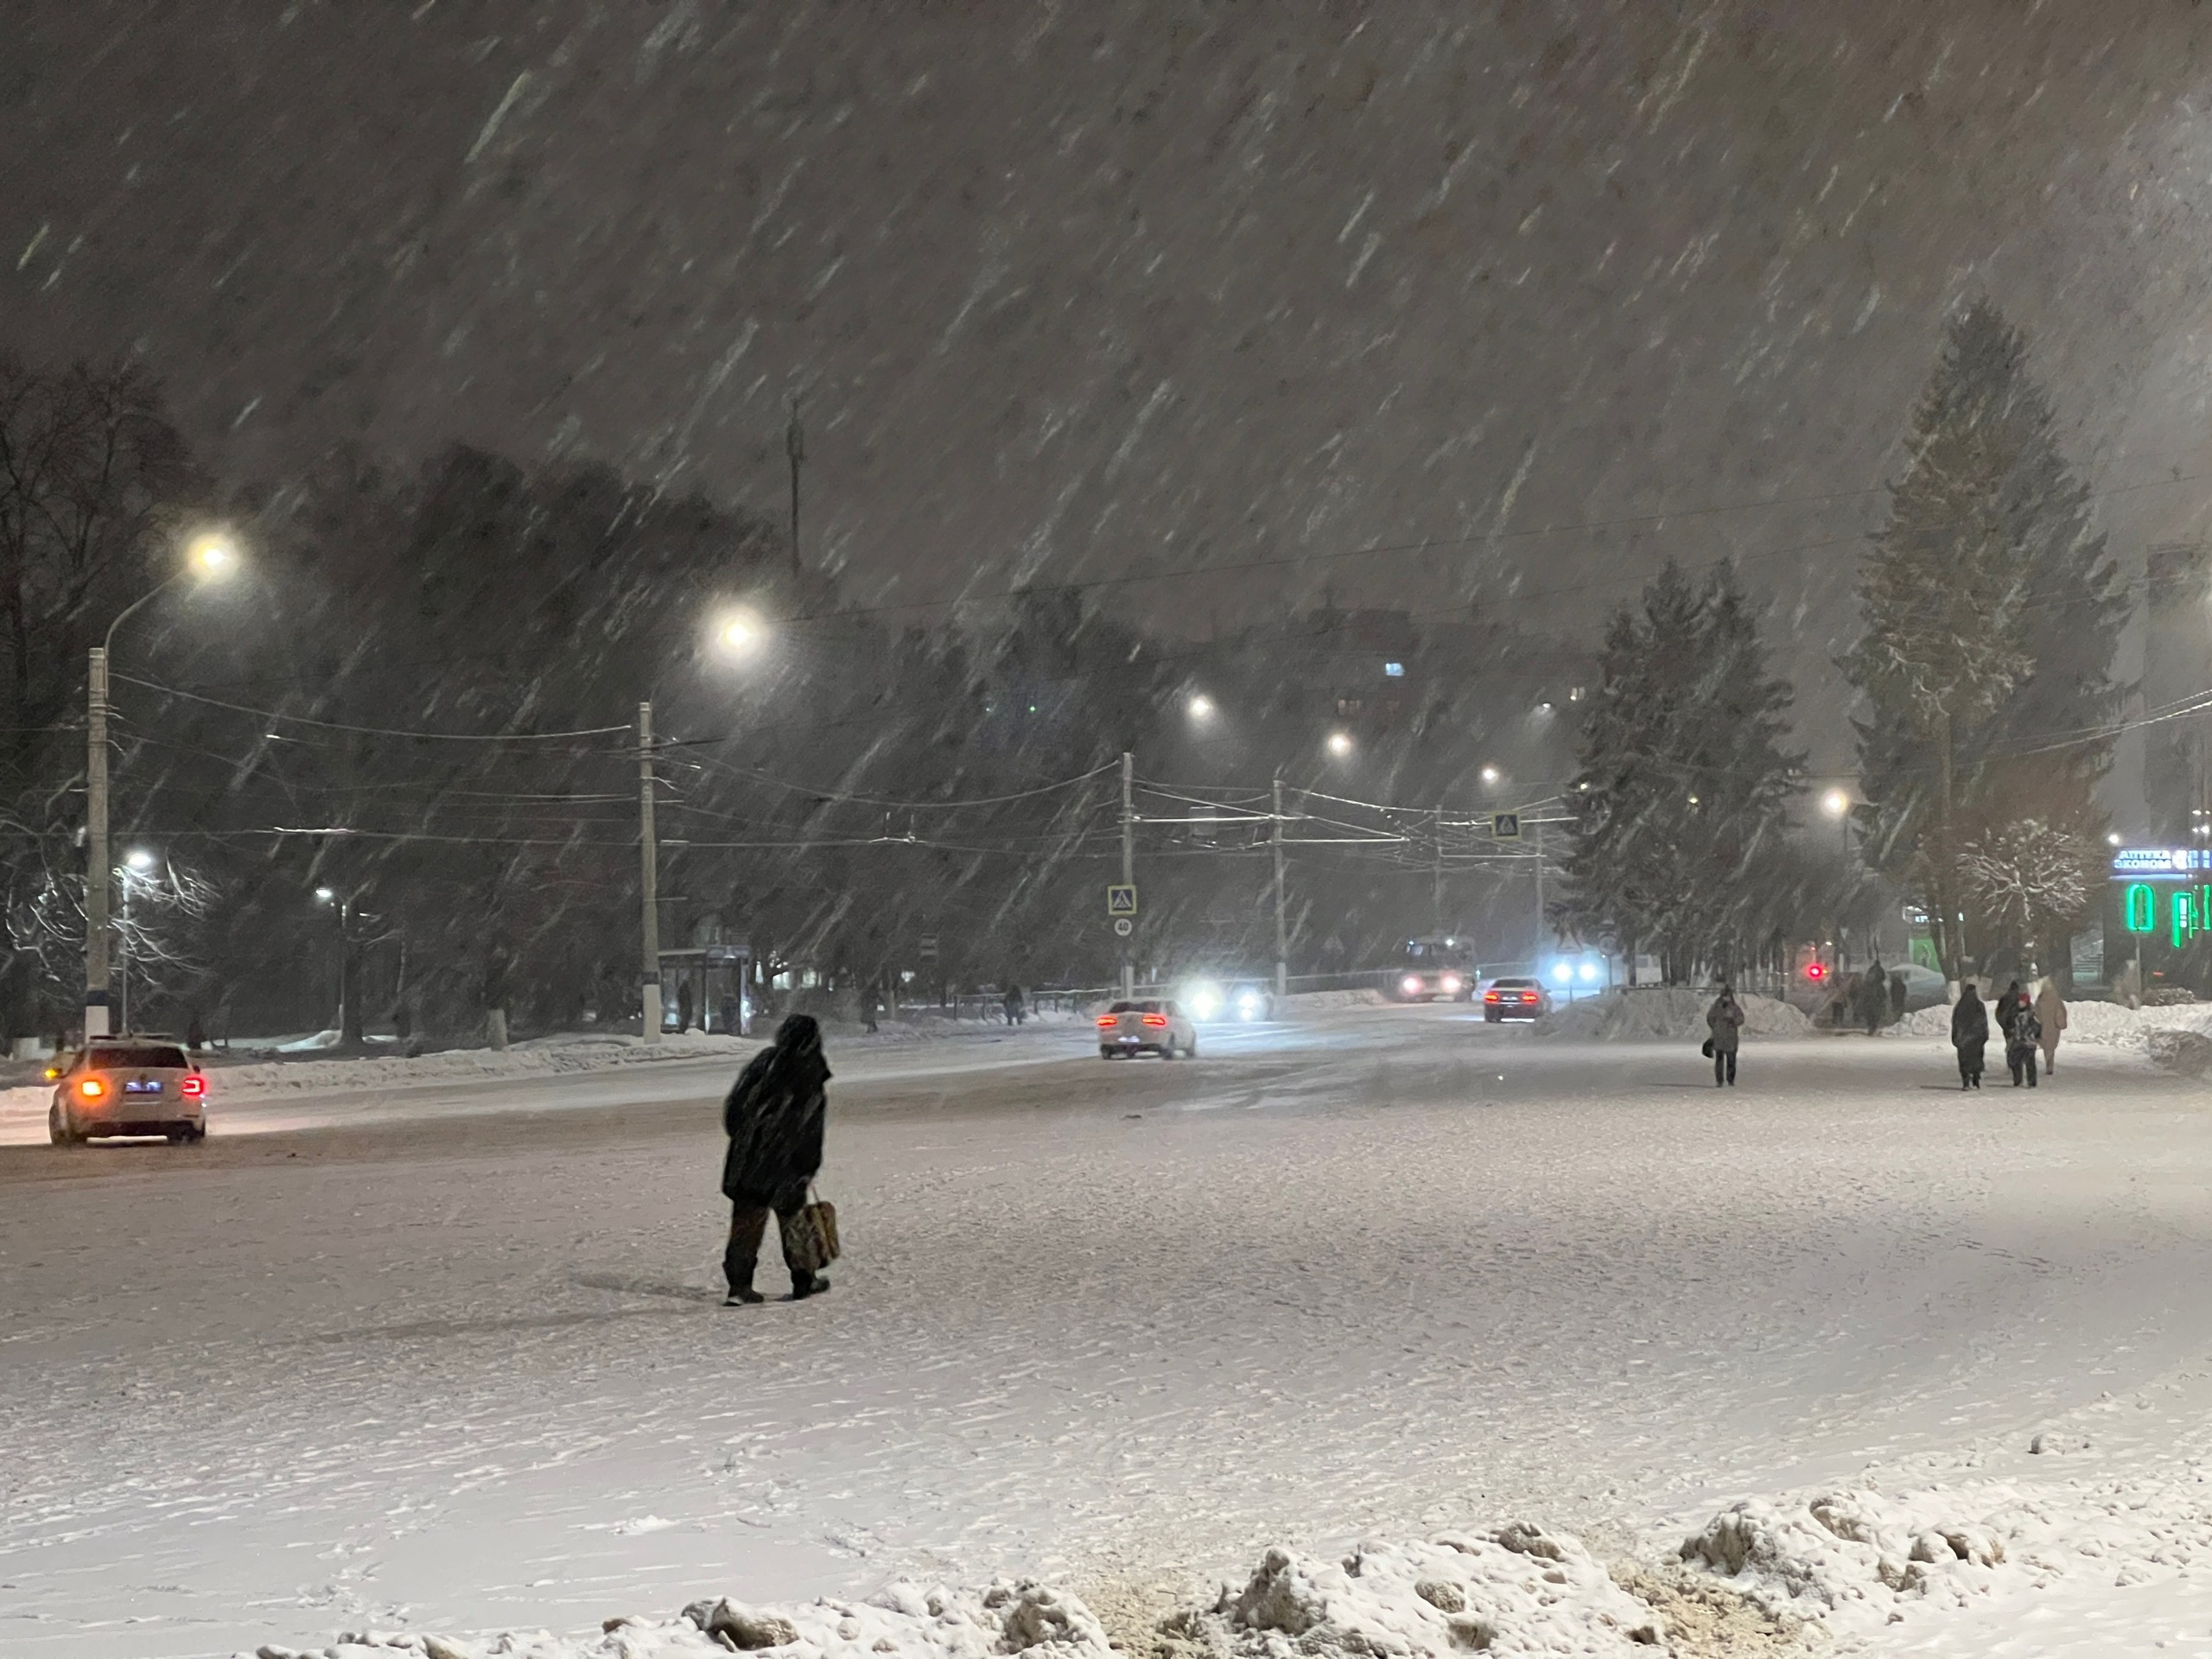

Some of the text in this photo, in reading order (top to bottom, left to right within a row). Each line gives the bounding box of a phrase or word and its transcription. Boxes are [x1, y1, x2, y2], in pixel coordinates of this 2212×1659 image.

[2119, 849, 2171, 859] АПТЕКА
[2114, 859, 2172, 869] ЭКОНОМ
[1117, 922, 1129, 931] 40
